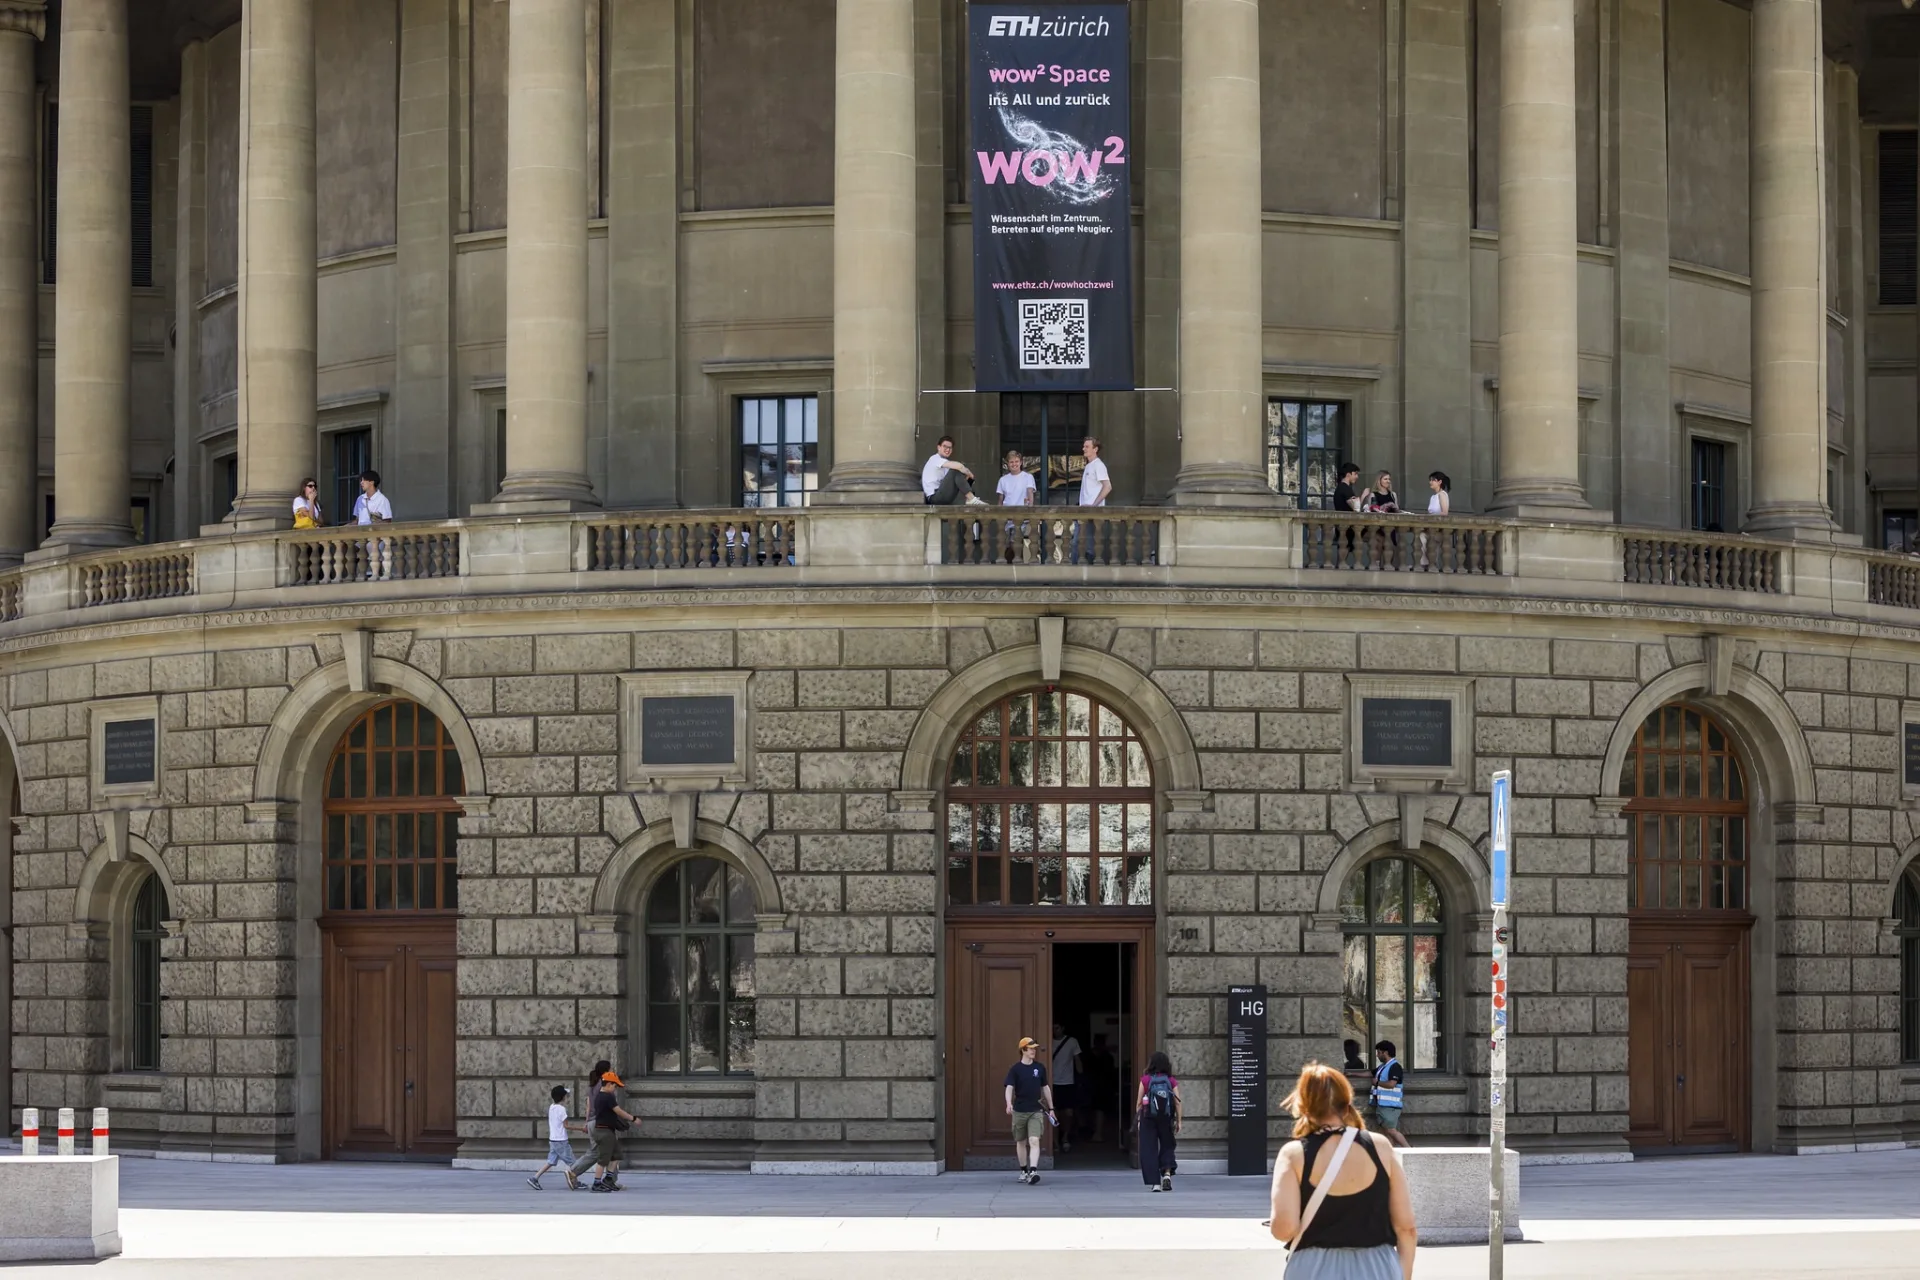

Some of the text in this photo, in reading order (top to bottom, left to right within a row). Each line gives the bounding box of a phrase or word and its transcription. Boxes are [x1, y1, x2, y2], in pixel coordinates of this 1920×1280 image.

[1049, 65, 1111, 87] Space
[989, 94, 1111, 106] ins All und zurück
[991, 214, 1103, 223] Wissenschaft im Zentrum.
[991, 224, 1113, 235] Betreten auf eigene Neugier.
[992, 279, 1114, 290] www.ethz.ch/wowhochzwei
[1179, 928, 1199, 940] 101
[1241, 1001, 1264, 1016] HG
